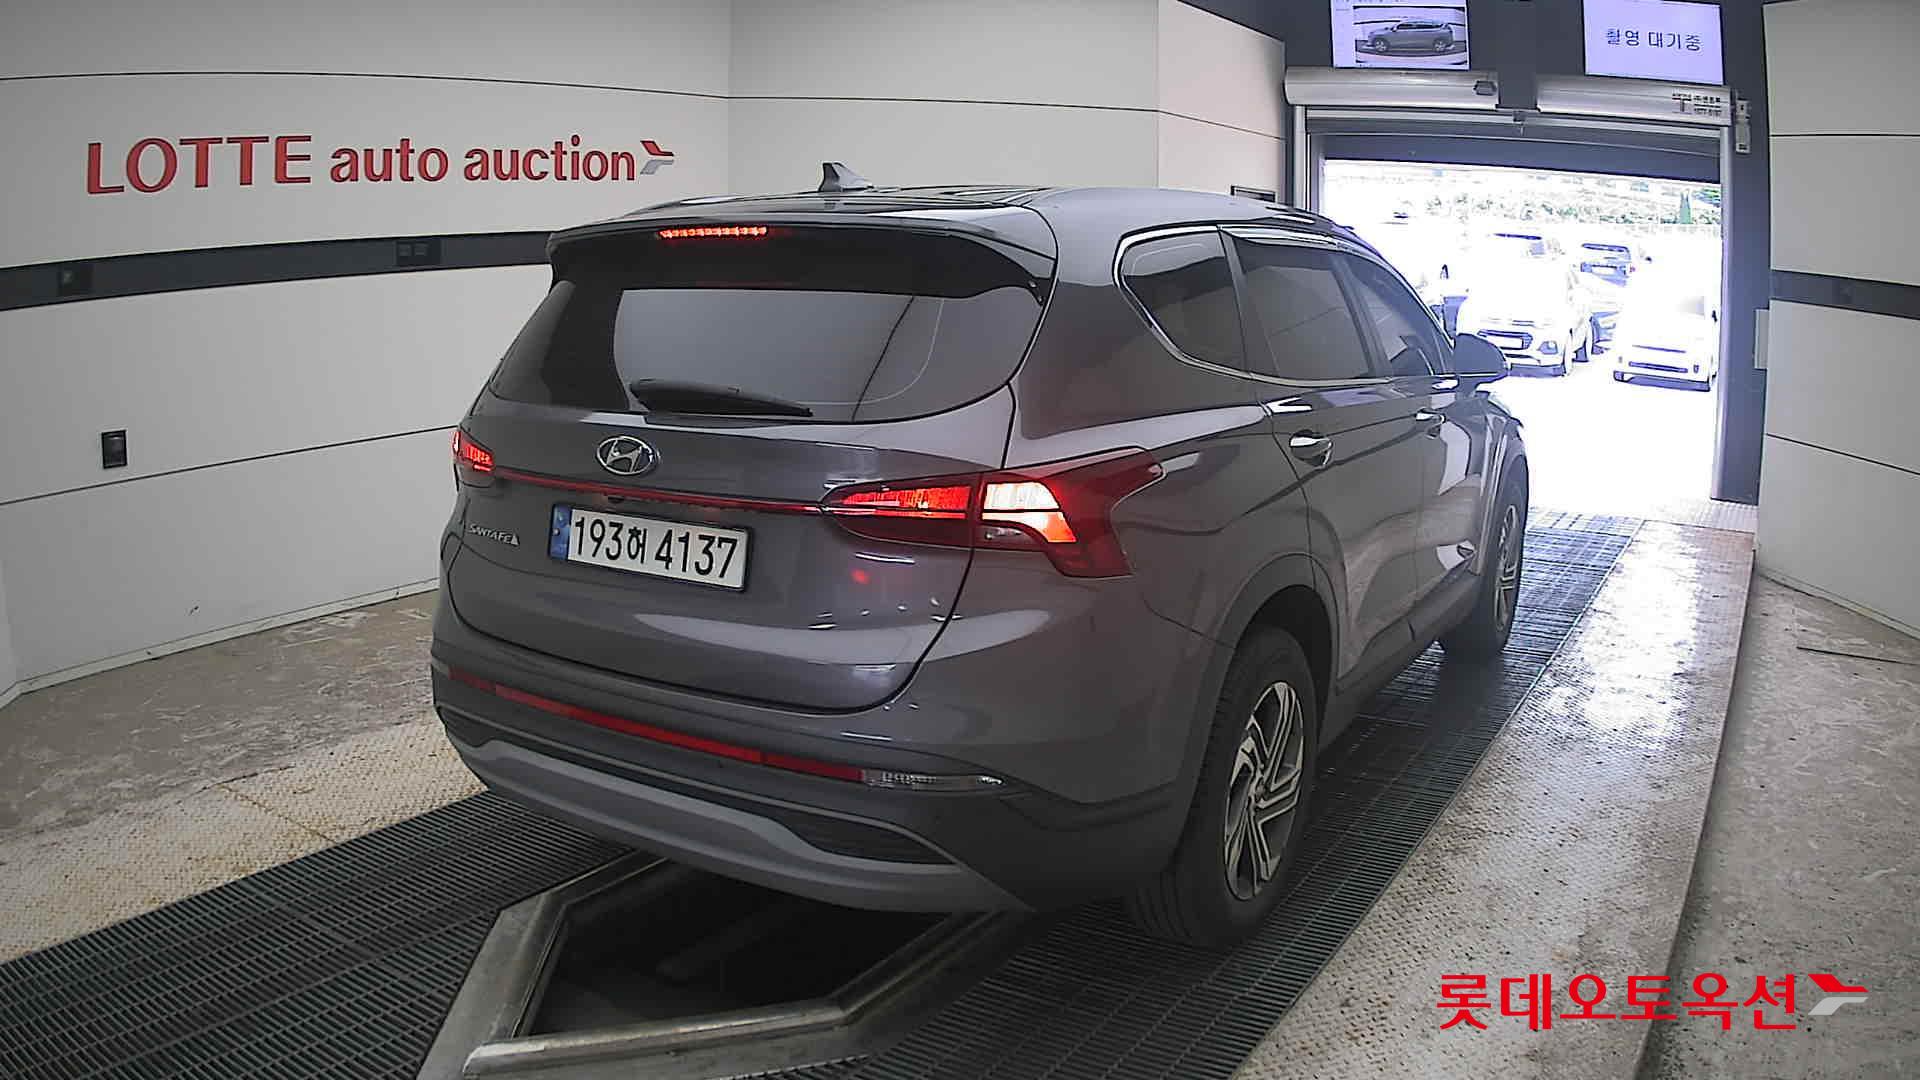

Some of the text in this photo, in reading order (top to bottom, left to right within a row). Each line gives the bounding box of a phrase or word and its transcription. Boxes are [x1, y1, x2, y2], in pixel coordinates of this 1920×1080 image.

[1648, 31, 1702, 51] 대기중
[86, 134, 636, 195] LOTTE auto auction
[574, 516, 739, 579] 193허 4137
